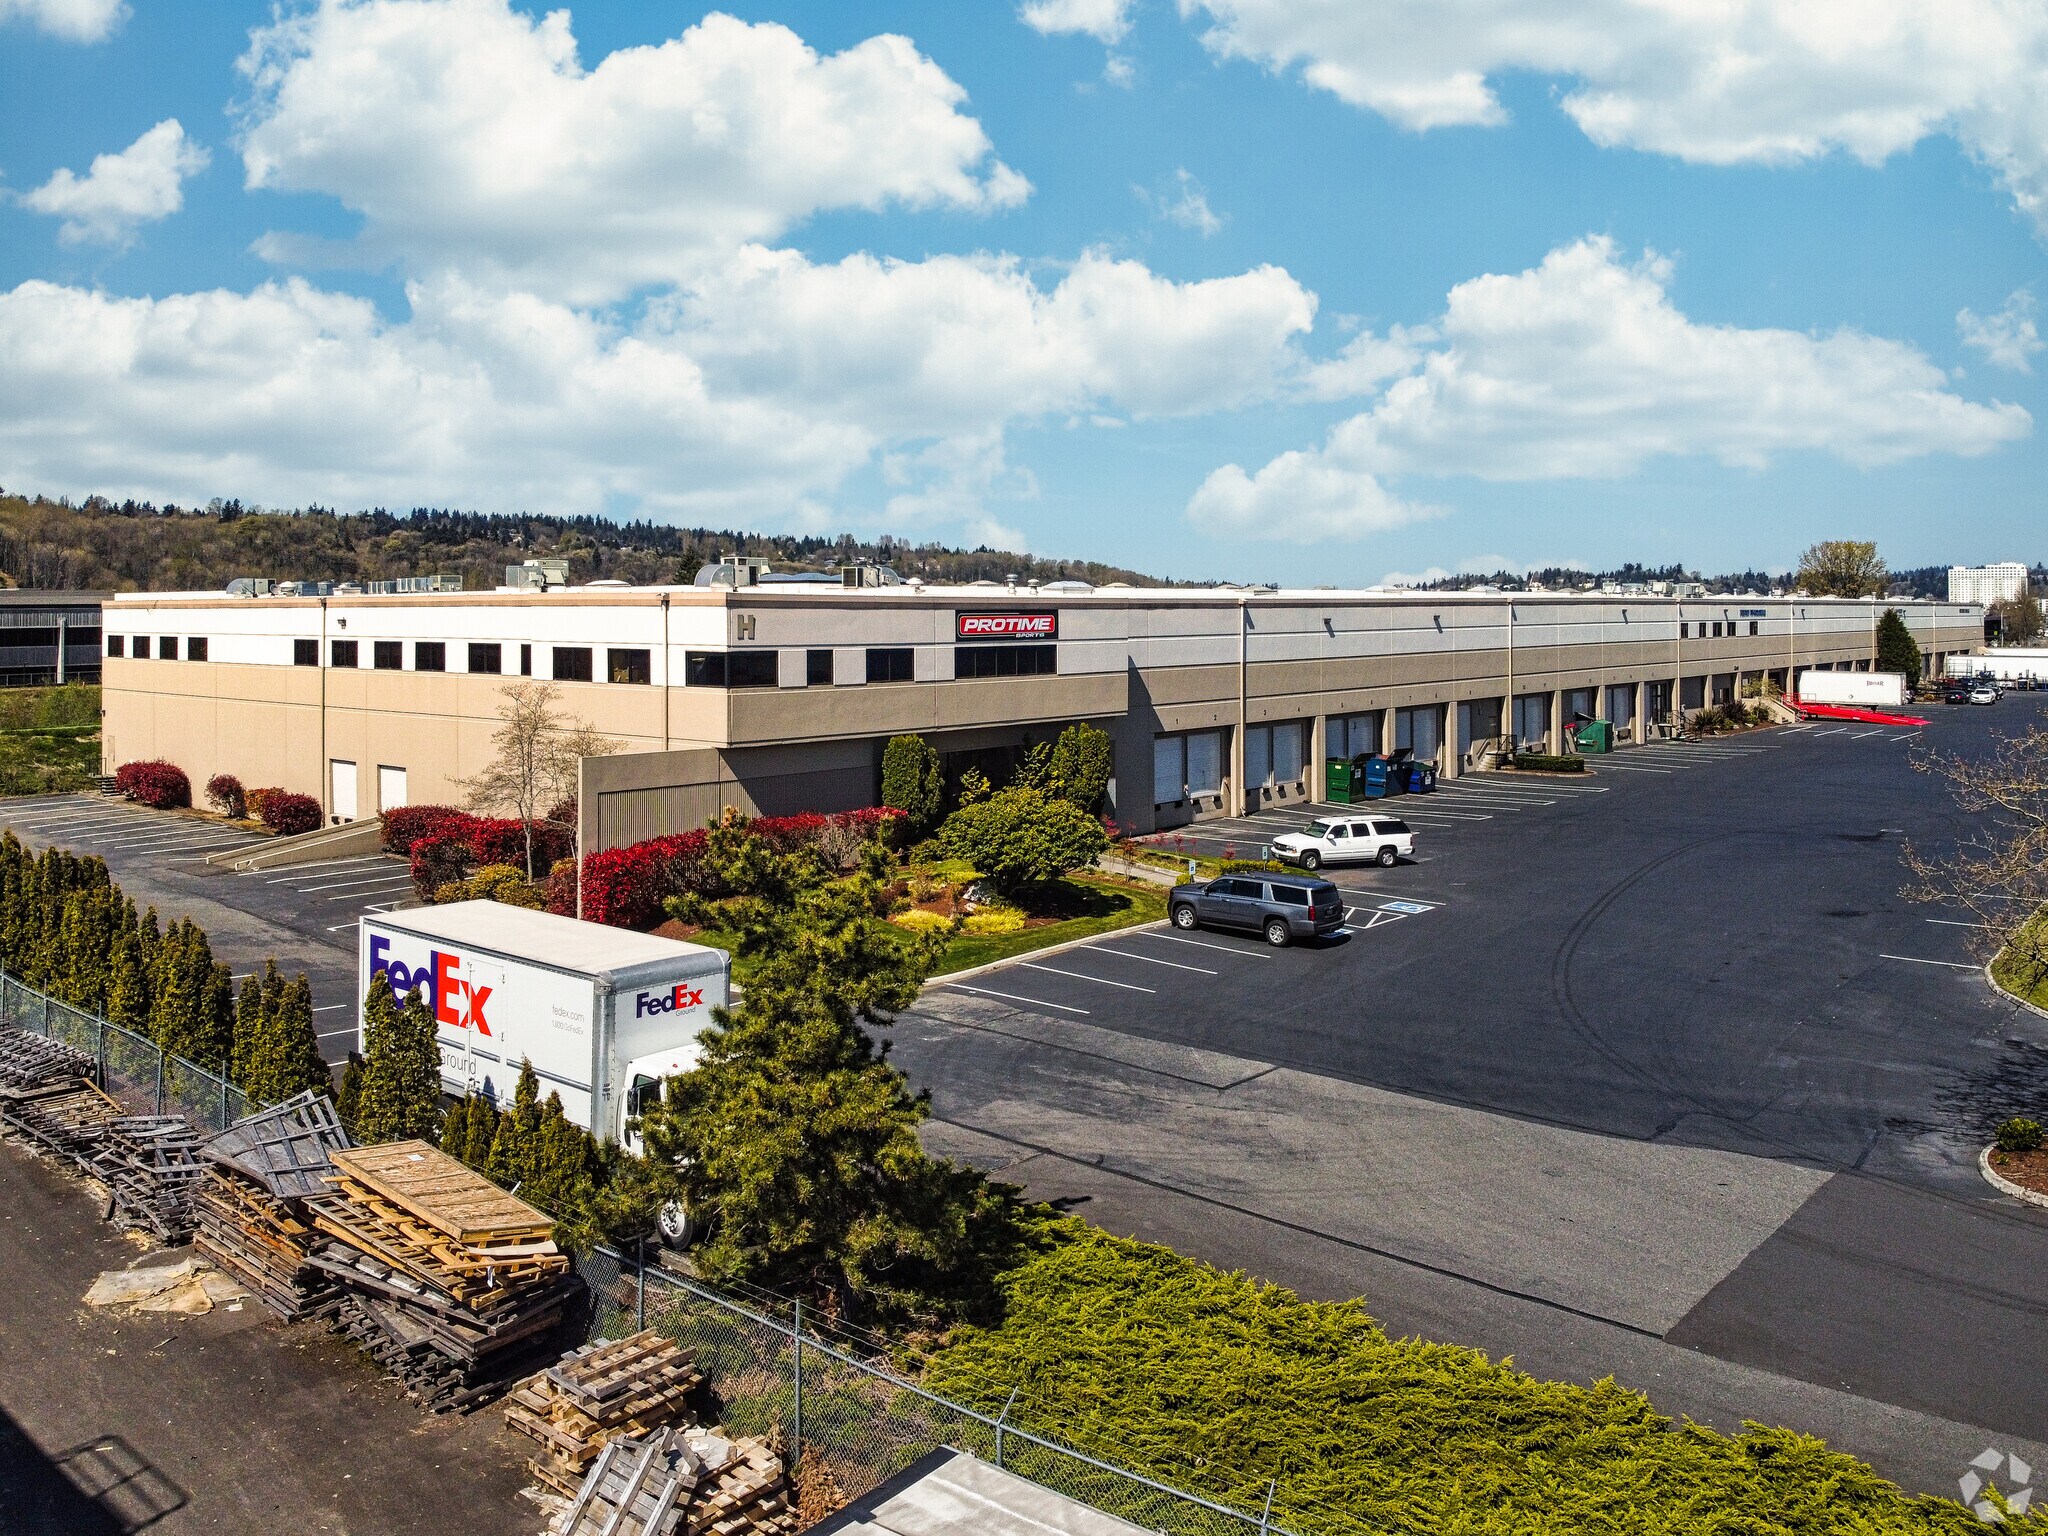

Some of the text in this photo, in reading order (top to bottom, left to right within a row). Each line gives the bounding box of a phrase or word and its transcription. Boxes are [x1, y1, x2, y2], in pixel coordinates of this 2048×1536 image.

[737, 614, 756, 641] H
[963, 618, 1052, 632] PROTIME
[370, 933, 493, 1037] FedEx
[636, 983, 704, 1019] FedEx
[676, 1006, 696, 1016] Ground
[552, 1003, 585, 1023] fedex.com
